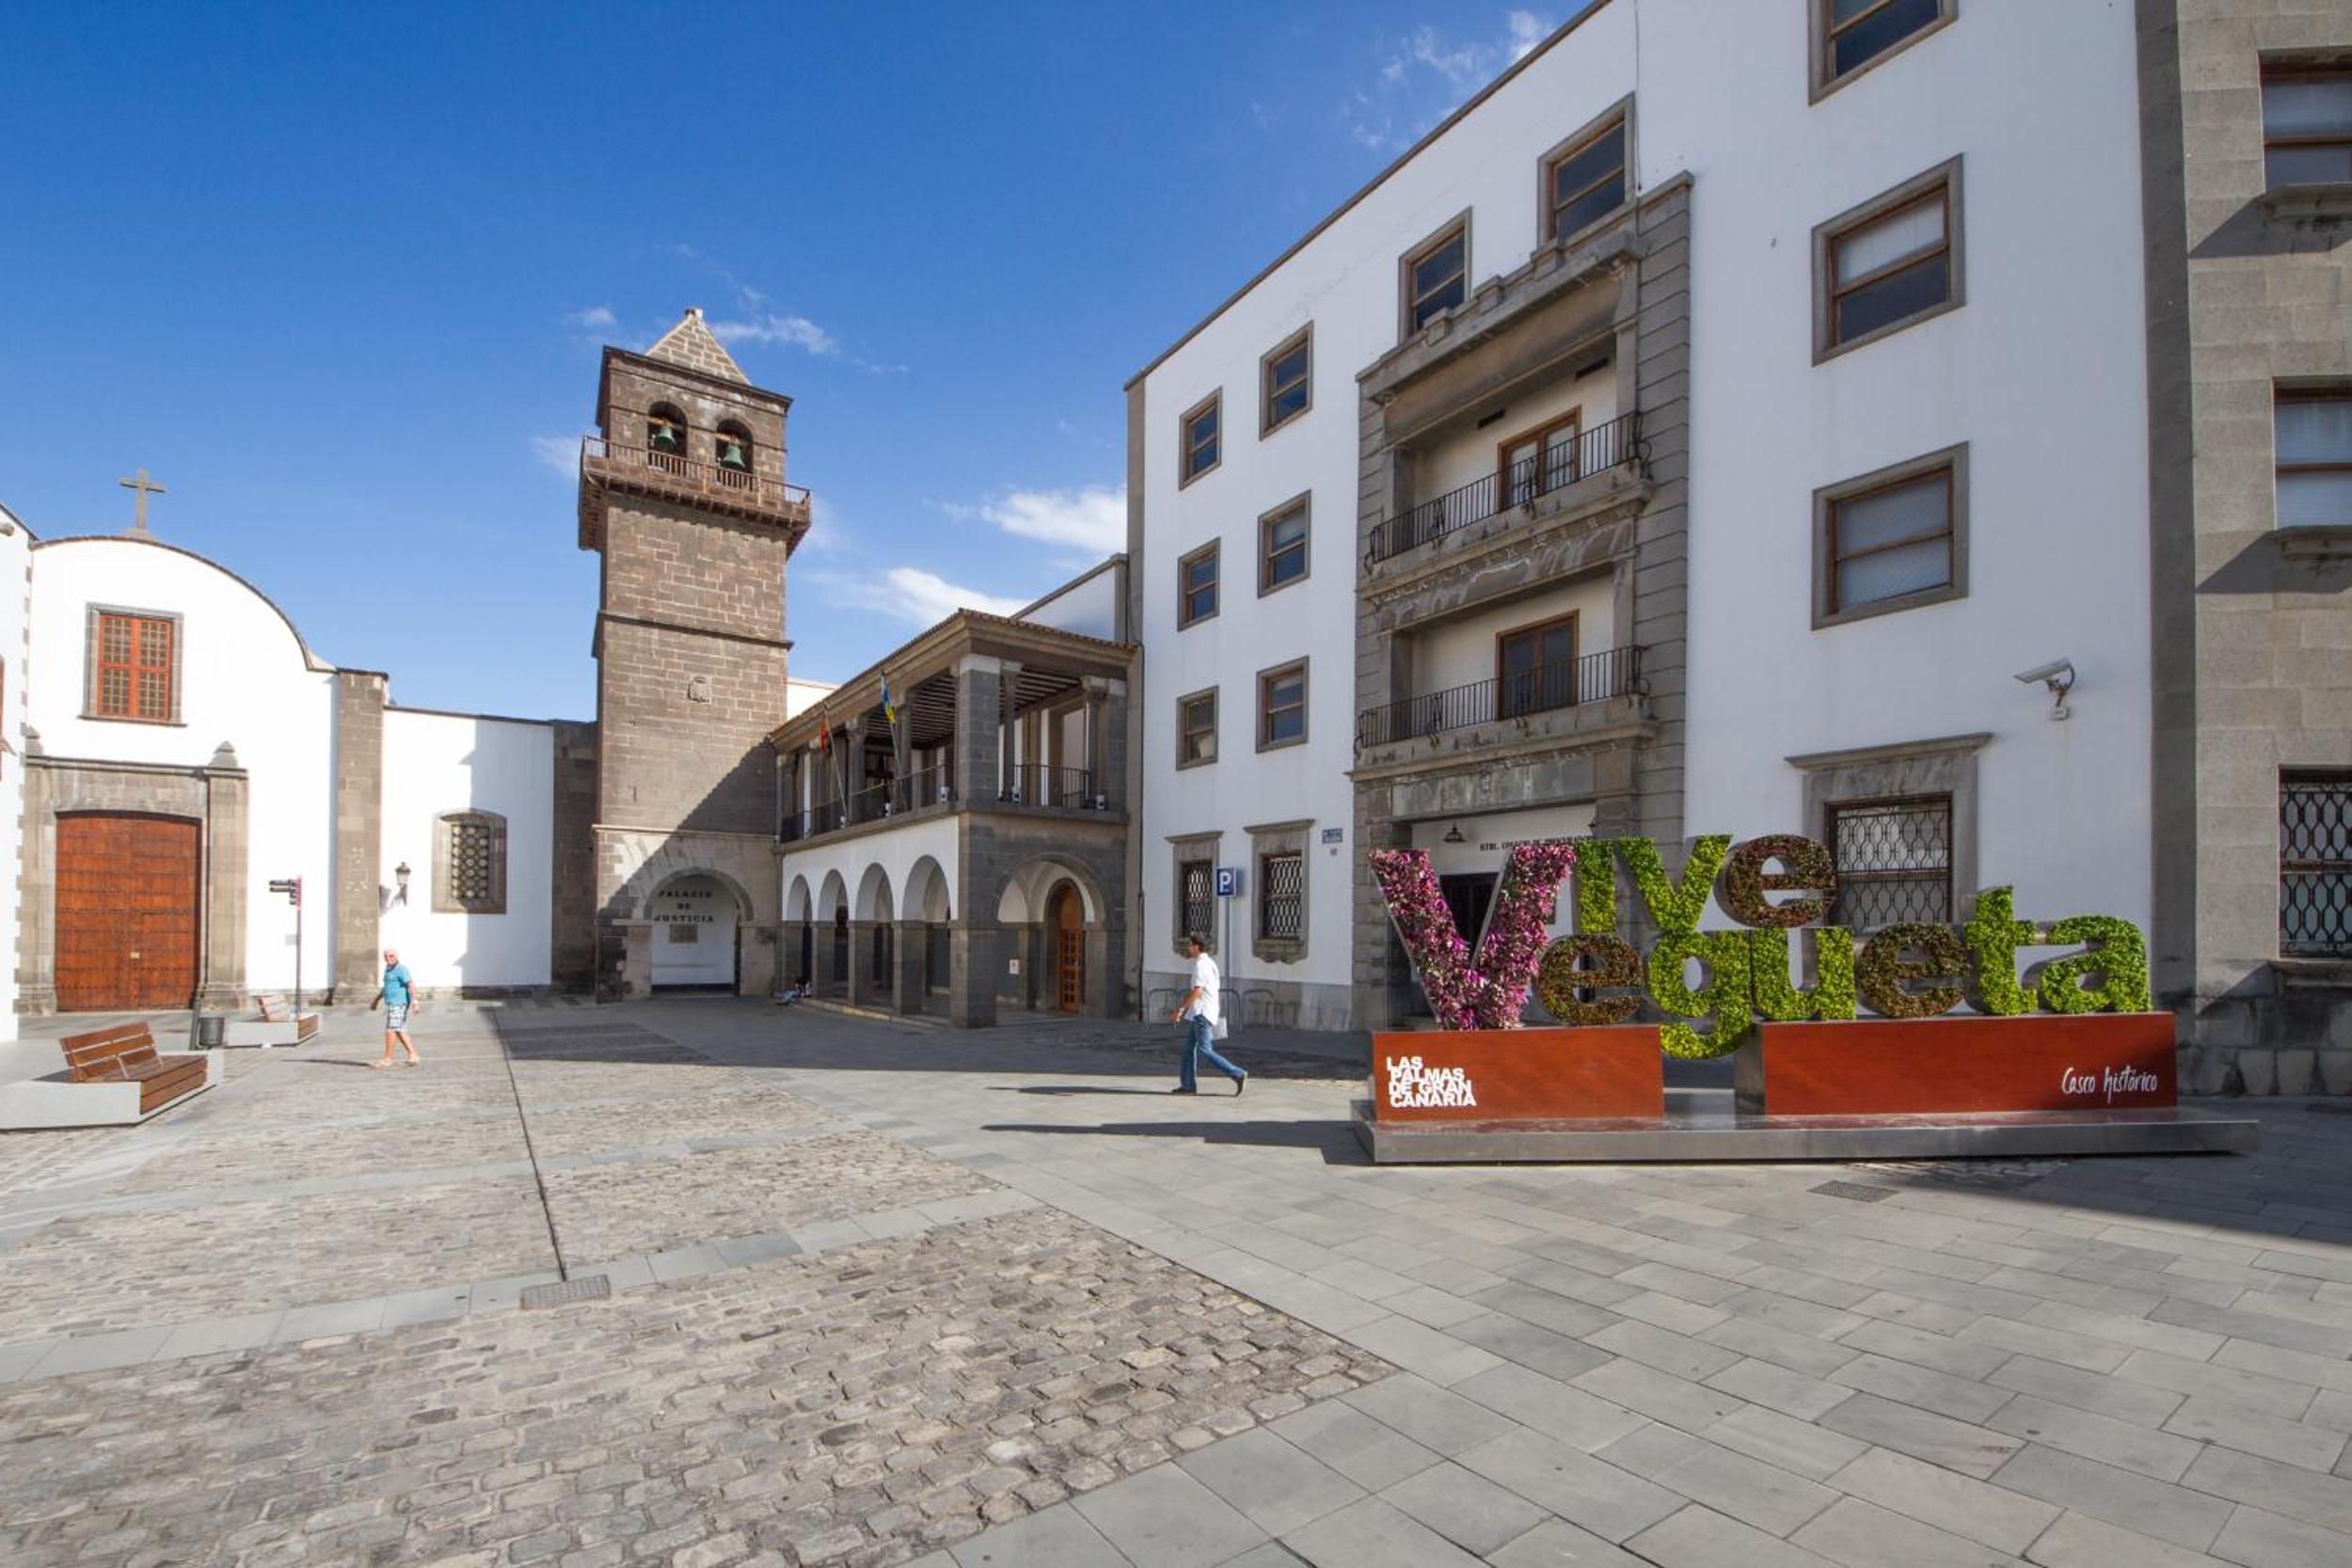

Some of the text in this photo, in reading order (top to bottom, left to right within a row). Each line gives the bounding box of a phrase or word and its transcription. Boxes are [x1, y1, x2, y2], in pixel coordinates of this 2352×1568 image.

[1219, 871, 1232, 893] P
[659, 890, 712, 898] PALACIO
[1386, 1056, 1422, 1071] LAS
[1391, 1066, 1465, 1083] PALMAS
[1389, 1079, 1472, 1095] DE GRAN
[2061, 1065, 2158, 1104] Casco histórico
[1391, 1091, 1477, 1108] CANARIA
